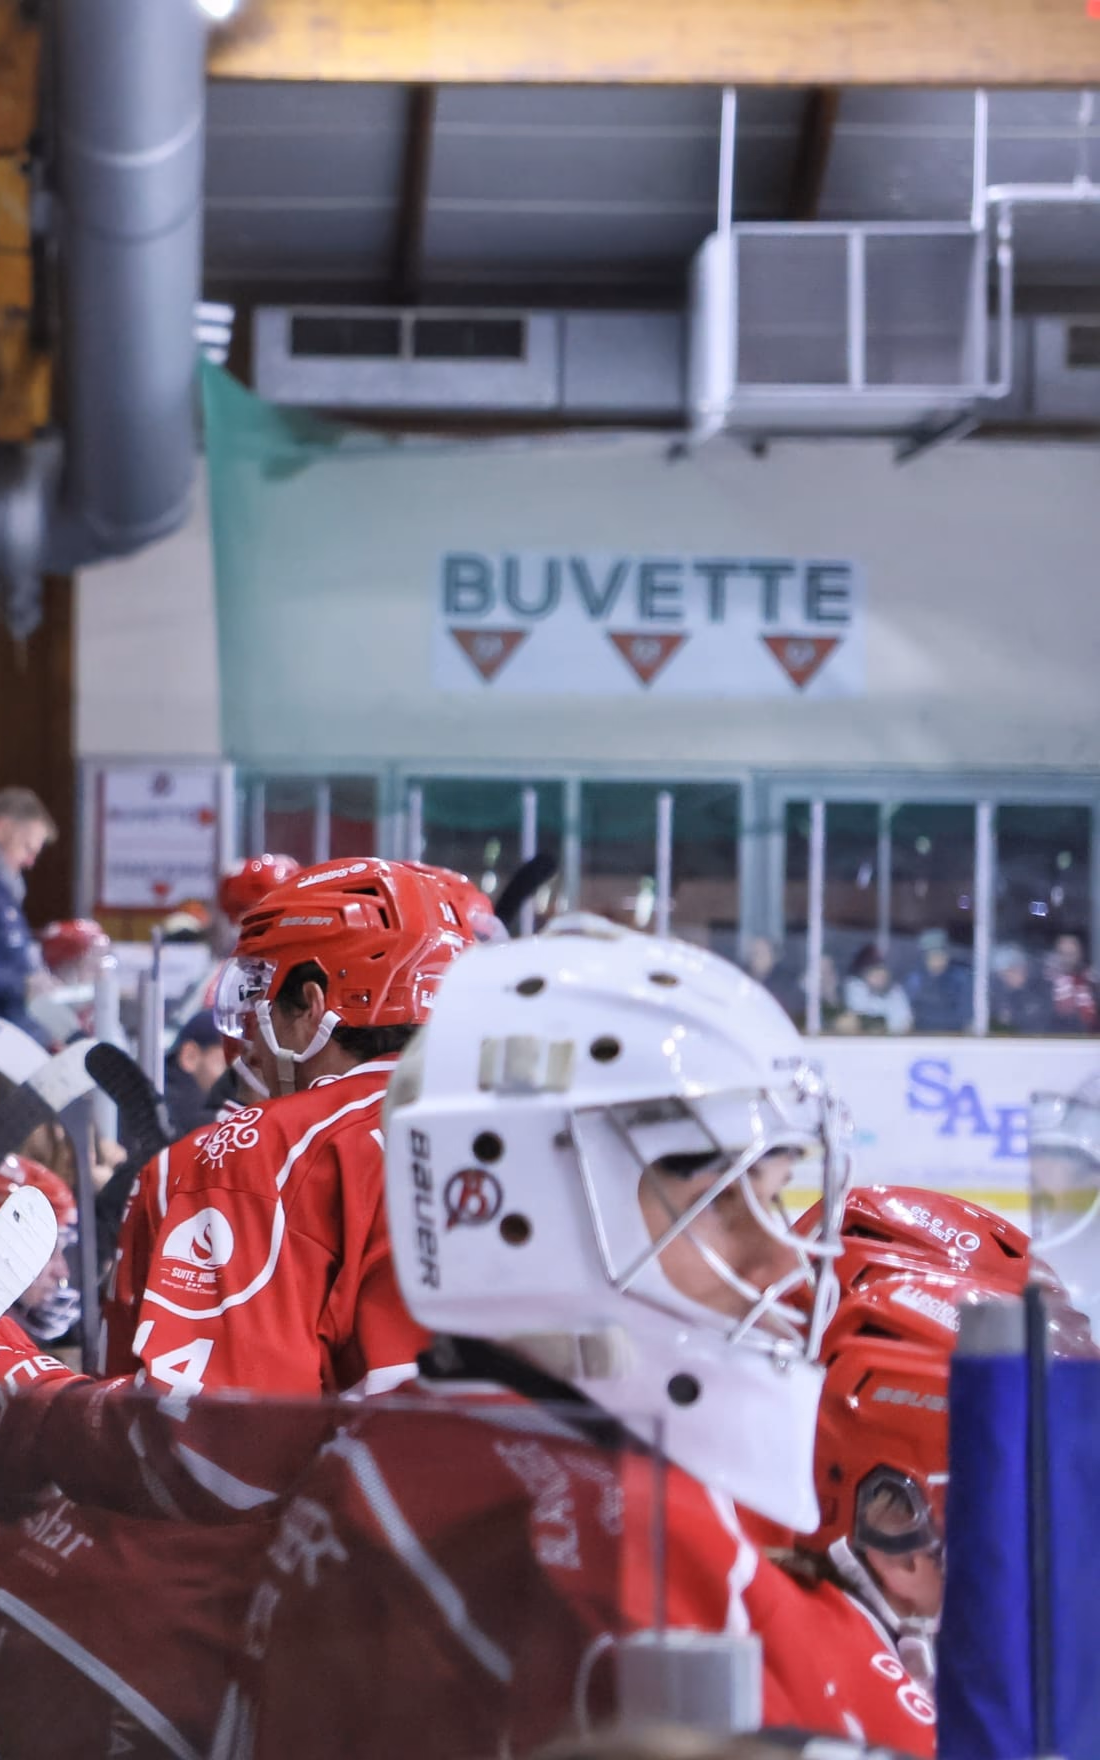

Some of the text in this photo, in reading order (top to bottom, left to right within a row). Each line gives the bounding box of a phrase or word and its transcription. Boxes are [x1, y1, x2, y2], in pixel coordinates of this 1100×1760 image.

[442, 552, 852, 627] BUVETTE
[411, 1128, 440, 1290] BAUER
[171, 1267, 197, 1281] SUITE
